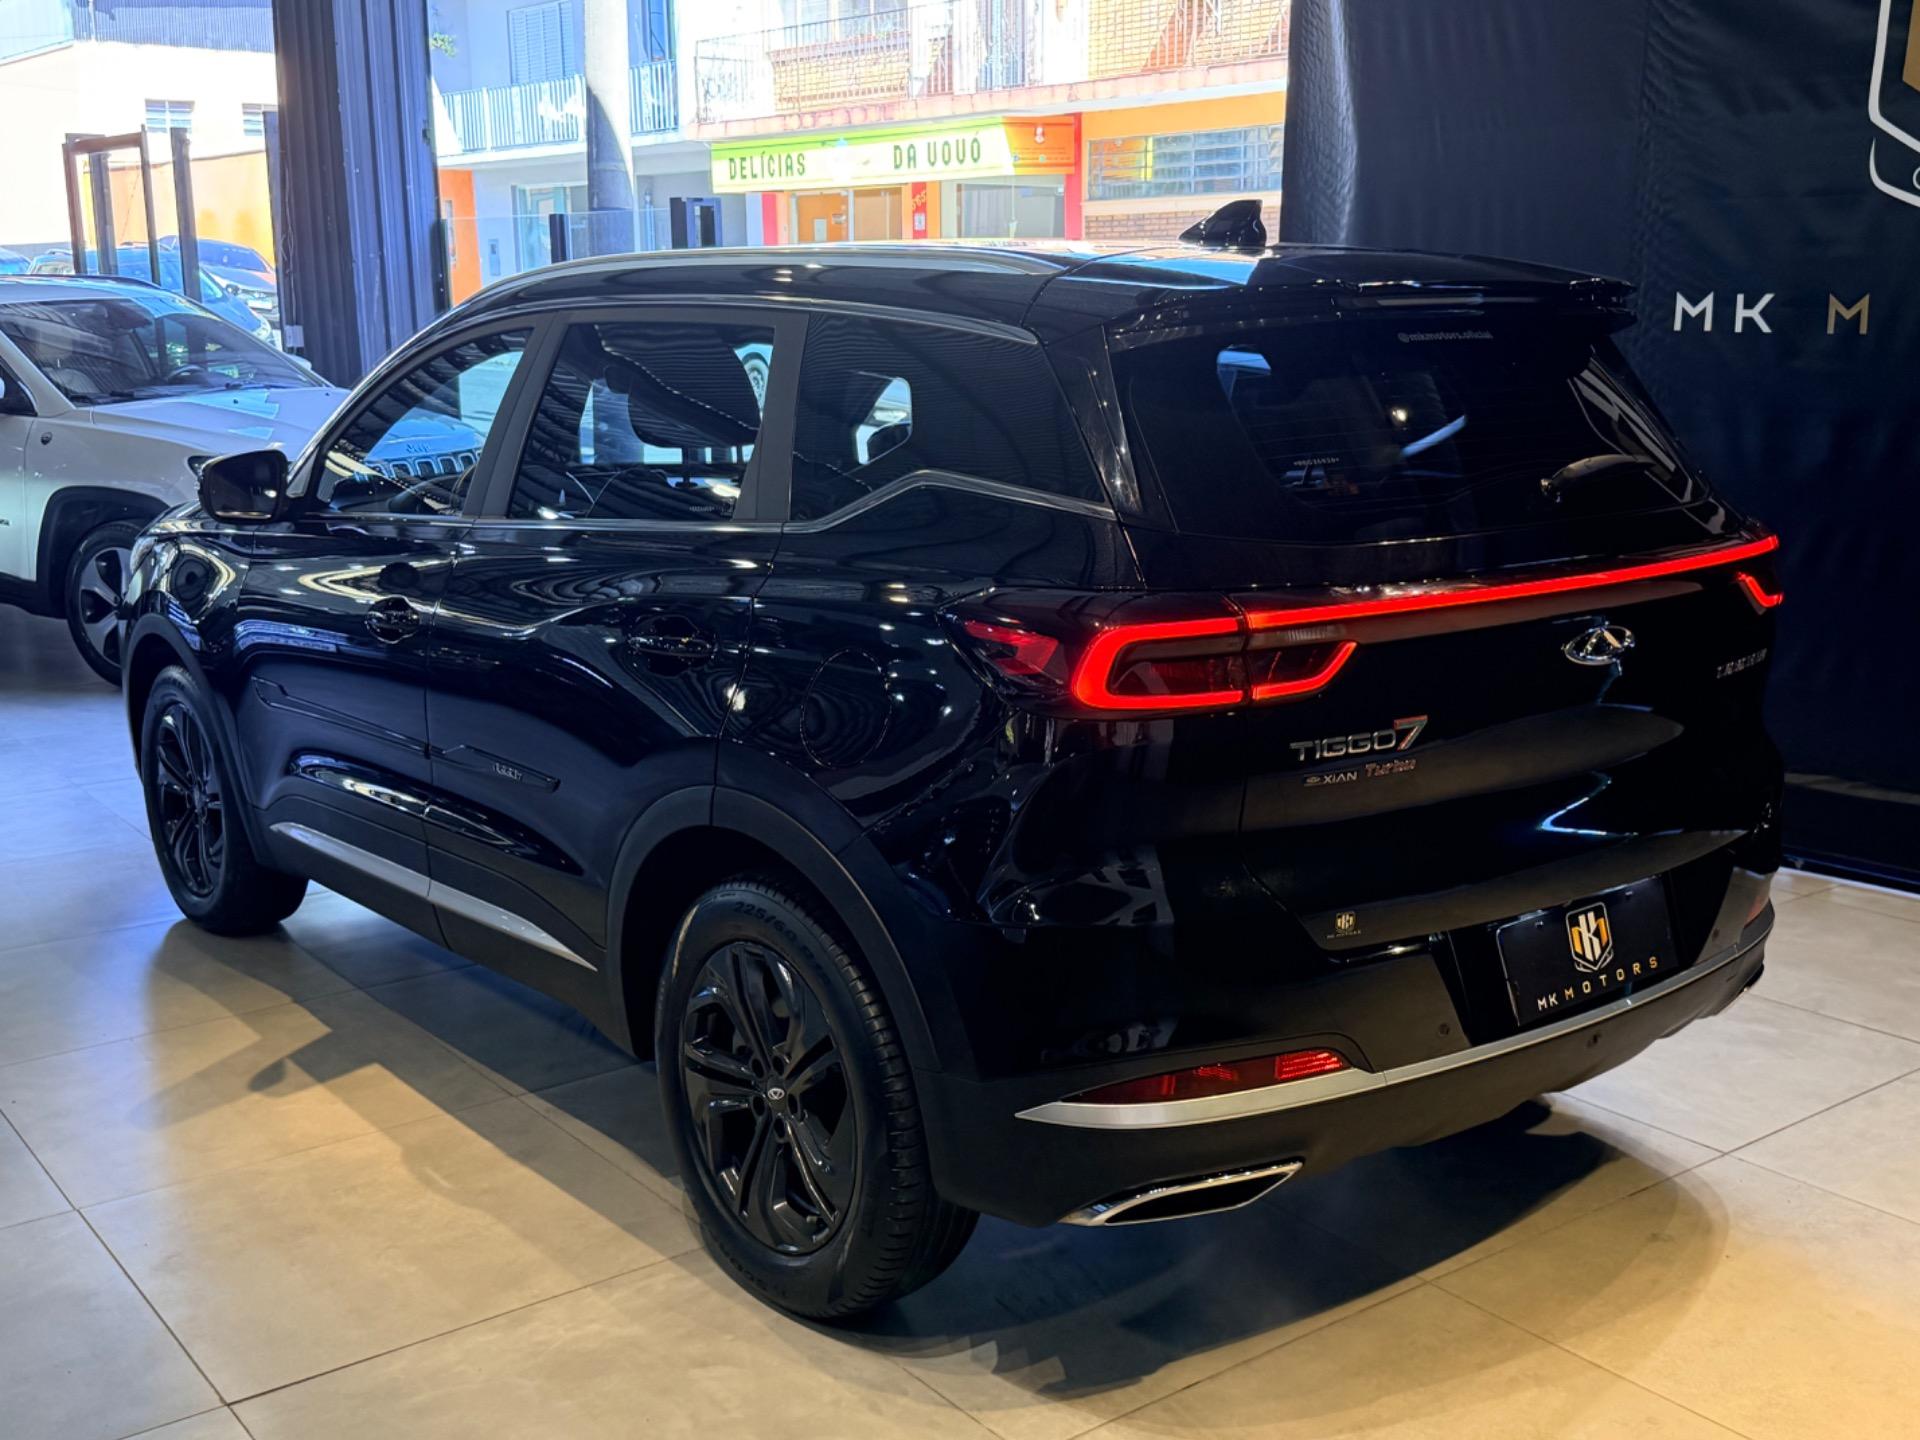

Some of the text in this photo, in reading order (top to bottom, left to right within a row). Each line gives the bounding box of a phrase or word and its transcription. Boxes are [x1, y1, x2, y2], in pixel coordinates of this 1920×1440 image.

[729, 151, 806, 180] DELÍCIAS
[893, 143, 917, 170] DA
[1673, 291, 1775, 333] MK
[1537, 956, 1658, 1011] MK MOTORS
